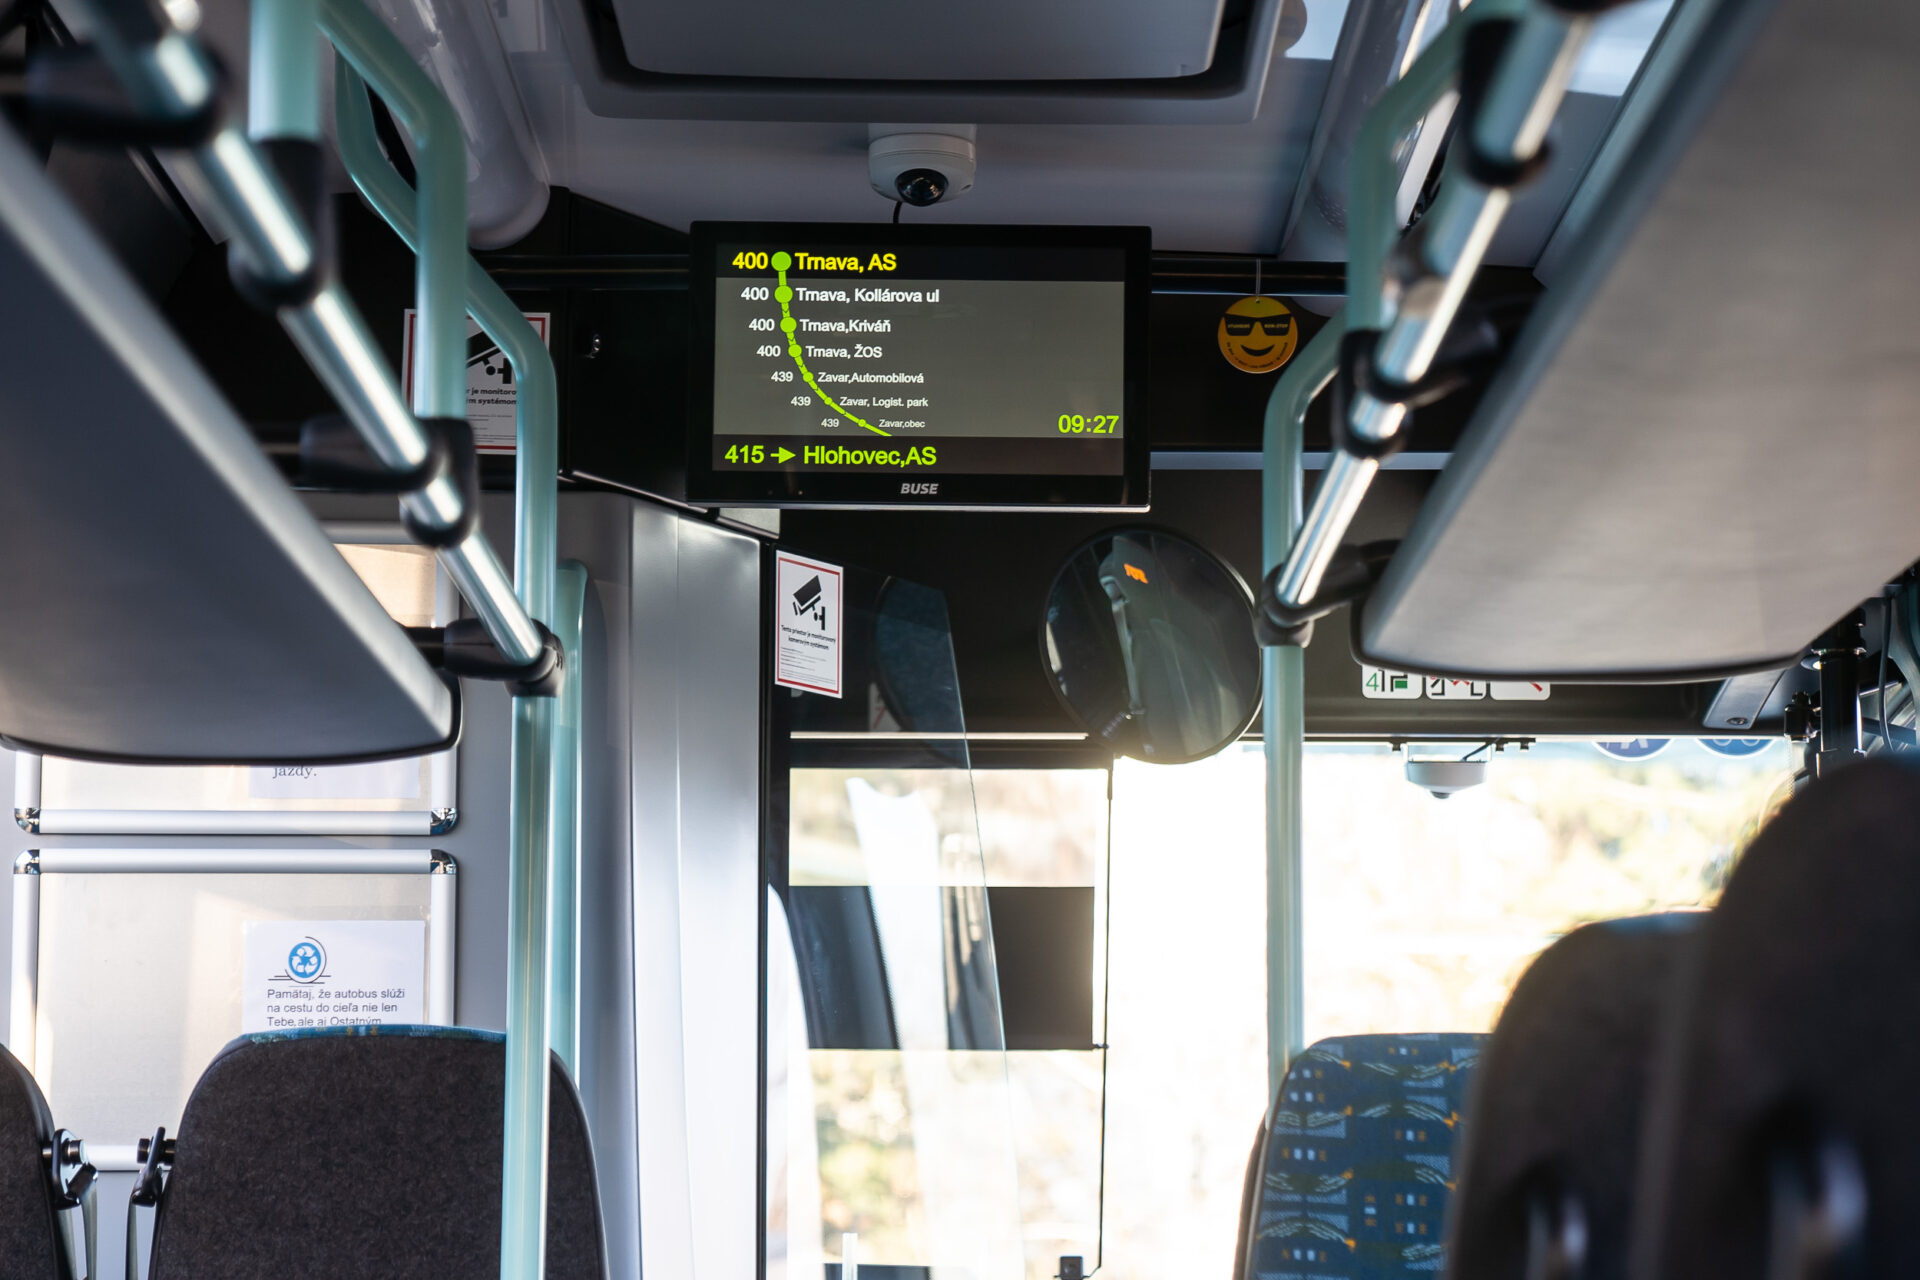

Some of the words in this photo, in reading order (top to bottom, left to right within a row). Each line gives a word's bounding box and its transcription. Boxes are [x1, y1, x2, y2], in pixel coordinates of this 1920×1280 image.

[732, 251, 769, 270] 400
[794, 252, 864, 274] Trnava,
[867, 253, 897, 271] AS
[740, 287, 769, 300] 400
[795, 287, 851, 304] Trnava,
[854, 288, 923, 303] Kollárova
[926, 289, 940, 303] ul
[748, 318, 775, 331] 400
[756, 345, 781, 357] 400
[805, 345, 851, 360] Trnava,
[853, 343, 883, 358] ŽOS
[770, 371, 794, 382] 439
[790, 396, 811, 406] 439
[839, 397, 871, 407] Zavar,
[872, 397, 904, 409] Logist.
[906, 397, 929, 409] park
[820, 418, 840, 428] 439
[1058, 414, 1119, 434] 09:27
[724, 445, 765, 464] 415
[900, 483, 939, 495] BUSE
[318, 988, 332, 999] že
[334, 988, 378, 999] autobus
[380, 988, 405, 999] slúži
[266, 1004, 280, 1012] na
[283, 1004, 313, 1013] cestu
[315, 1003, 330, 1012] do
[332, 1002, 359, 1012] cieľa
[361, 1003, 378, 1012] nie
[381, 1002, 398, 1012] len
[330, 1016, 382, 1026] Ostatným
